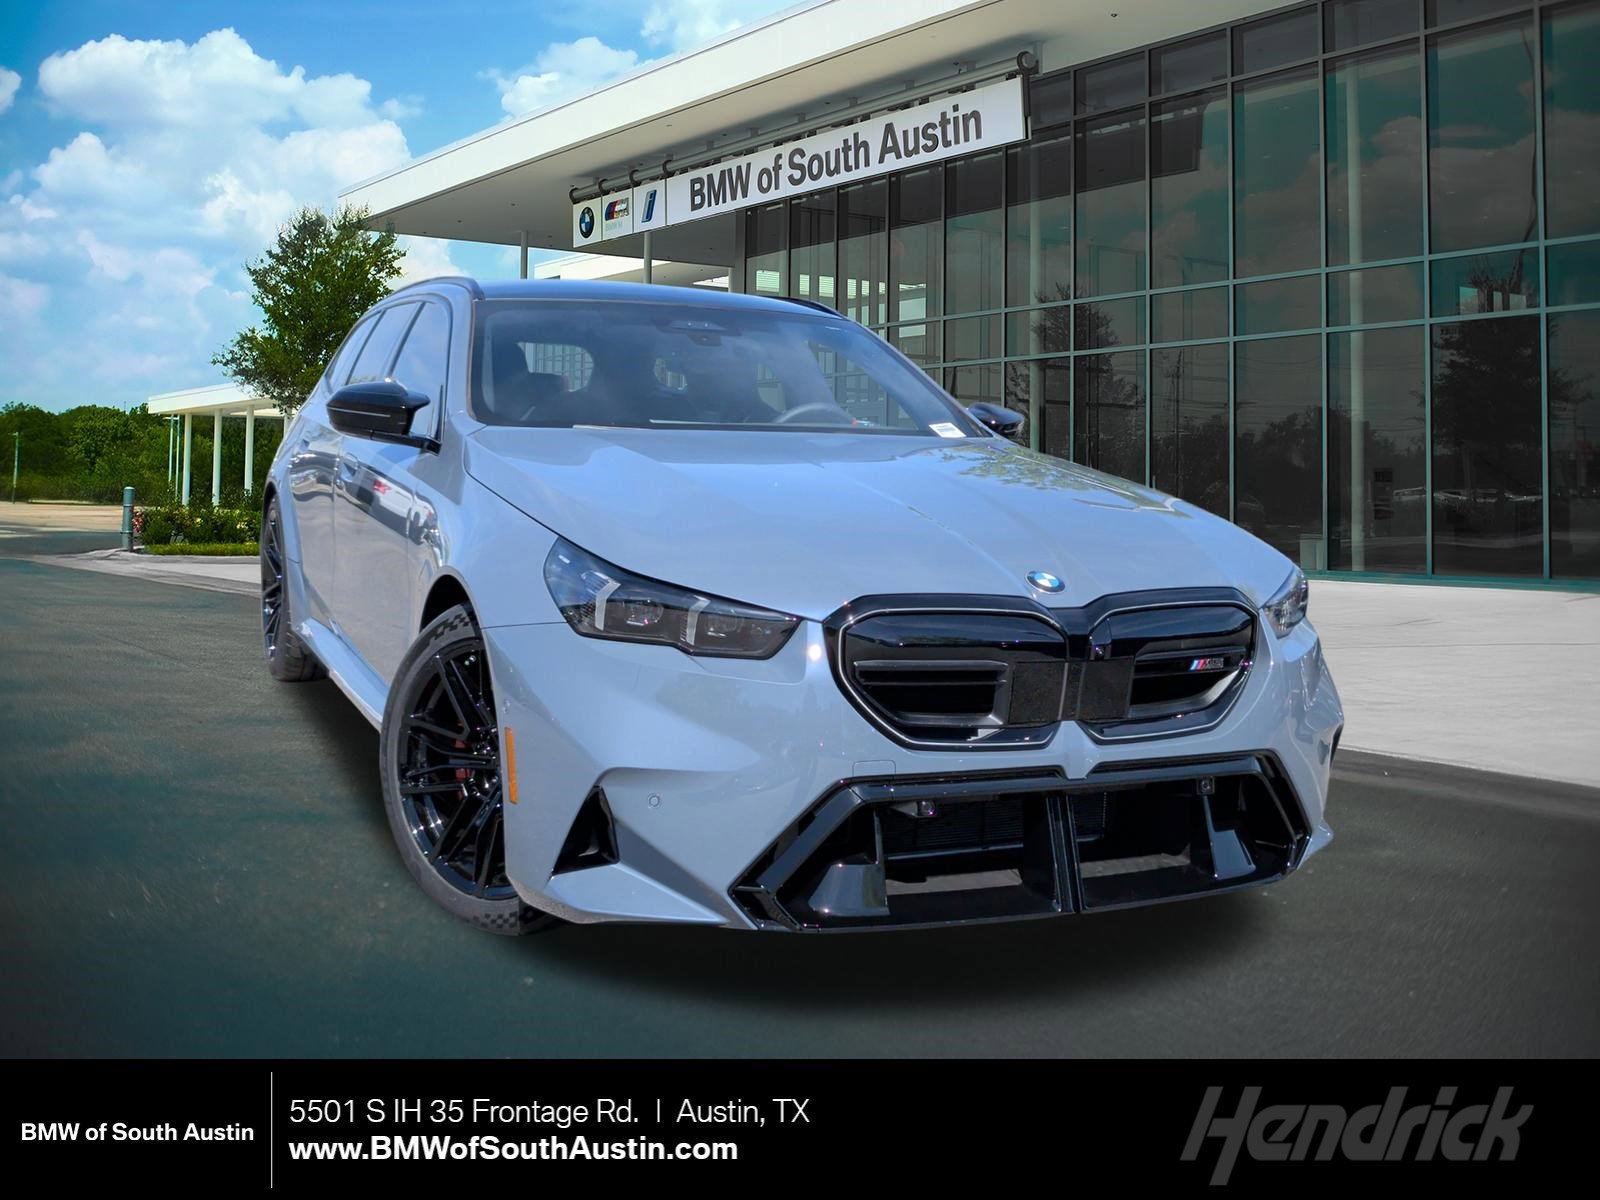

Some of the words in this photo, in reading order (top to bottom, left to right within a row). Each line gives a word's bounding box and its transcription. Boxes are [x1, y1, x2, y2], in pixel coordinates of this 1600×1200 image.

[690, 162, 751, 212] BMW
[757, 153, 783, 194] of
[787, 132, 871, 186] South
[878, 104, 983, 164] Austin
